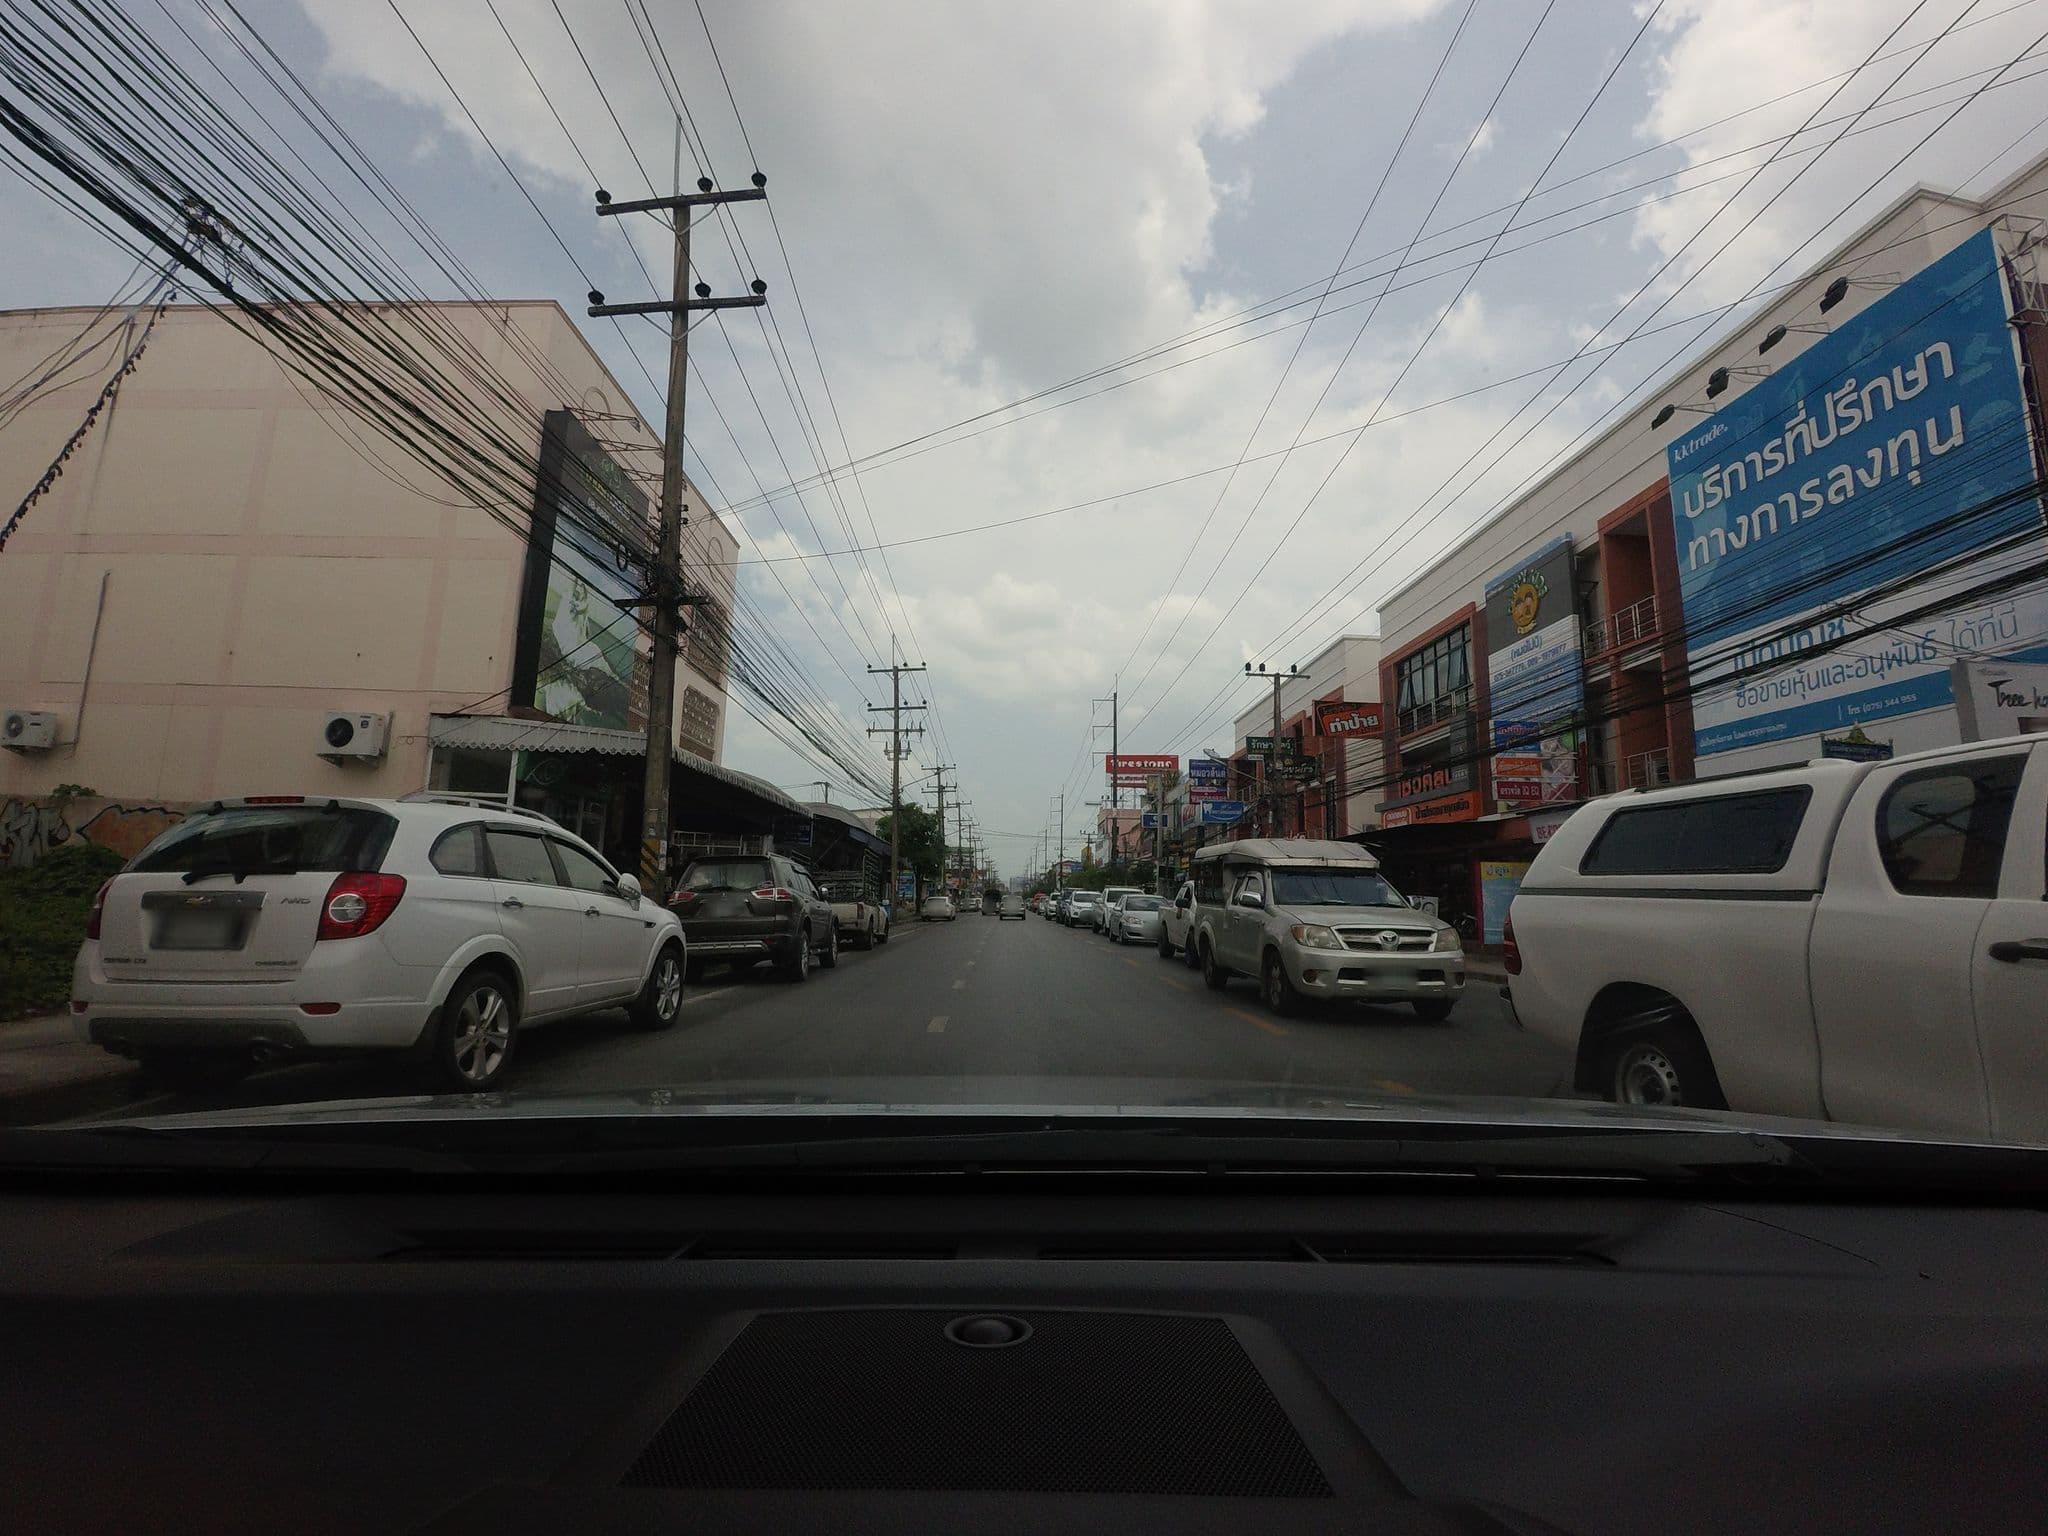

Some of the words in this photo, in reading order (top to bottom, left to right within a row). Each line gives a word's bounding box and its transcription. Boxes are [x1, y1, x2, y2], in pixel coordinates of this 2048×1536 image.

[1683, 341, 1954, 519] บริการที่ปรึกษา
[1688, 404, 1965, 571] ทางการลงทุน
[1736, 630, 1938, 709] ซื้อขายหุ้นและอนุพันธ์
[1947, 603, 2018, 654] ได้ที่นี่
[1329, 711, 1380, 733] ทำป้าย
[1987, 678, 2033, 708] Tree
[1250, 737, 1291, 749] รักษาตว์
